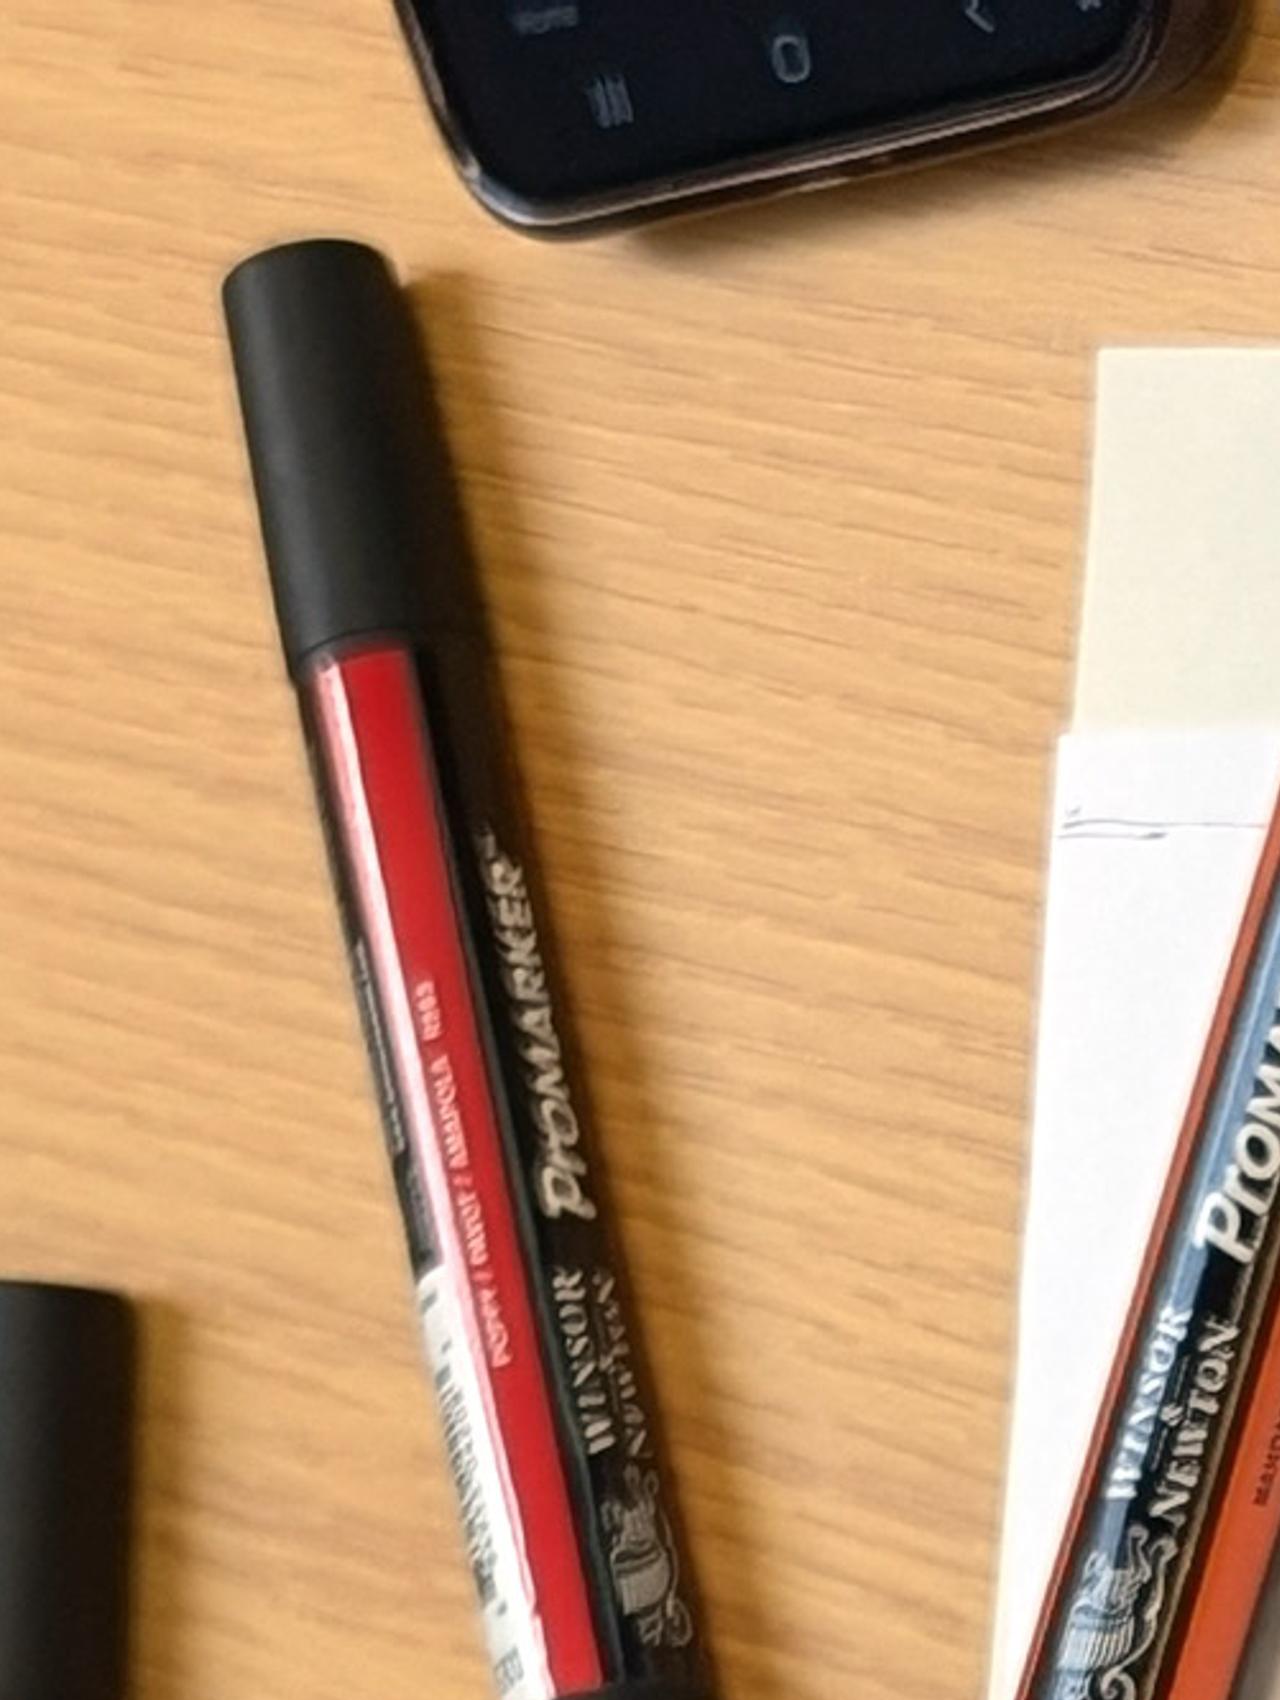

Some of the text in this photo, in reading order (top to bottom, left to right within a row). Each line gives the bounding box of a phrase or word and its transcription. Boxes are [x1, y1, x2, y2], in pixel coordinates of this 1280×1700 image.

[551, 1267, 616, 1455] WINSOR
[1106, 1305, 1193, 1500] WINSOR
[1150, 1313, 1241, 1531] NEWTON
